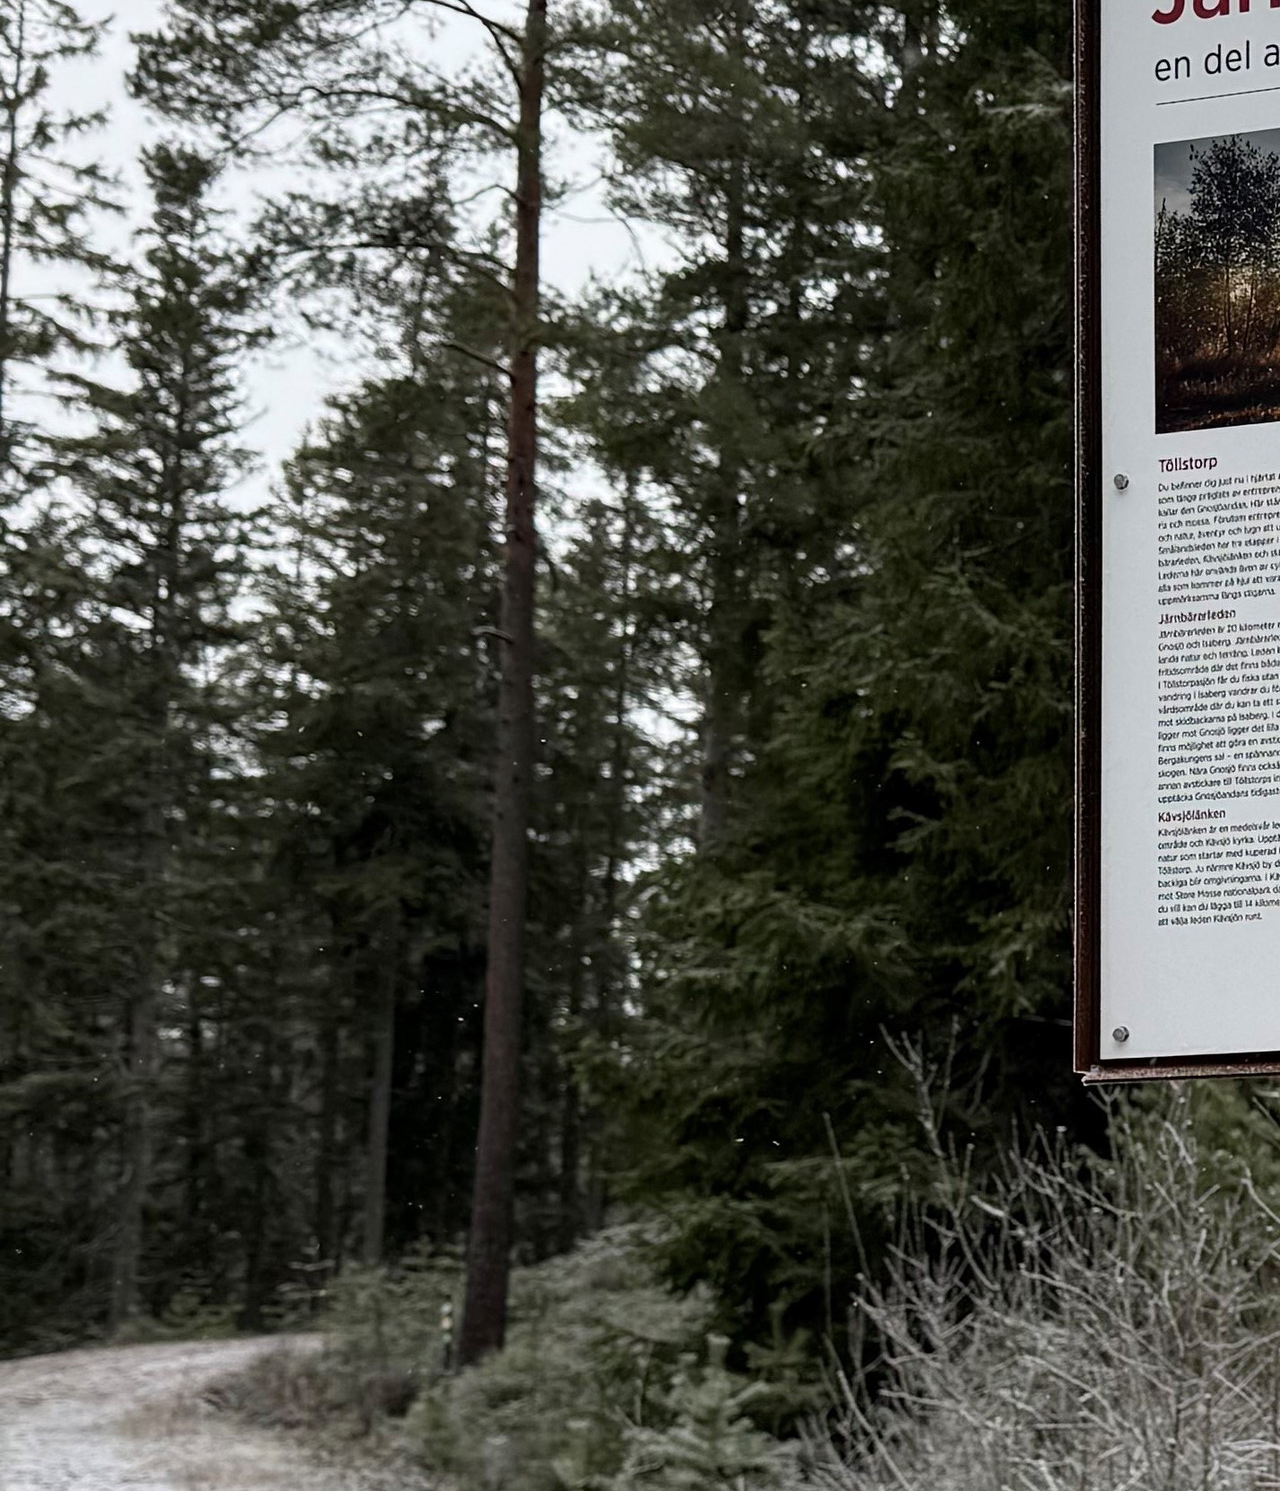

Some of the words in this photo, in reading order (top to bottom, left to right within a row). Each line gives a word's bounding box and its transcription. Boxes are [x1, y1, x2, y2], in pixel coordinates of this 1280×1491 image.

[1155, 56, 1189, 81] en
[1204, 40, 1249, 74] del
[1158, 457, 1217, 472] Töllstorp
